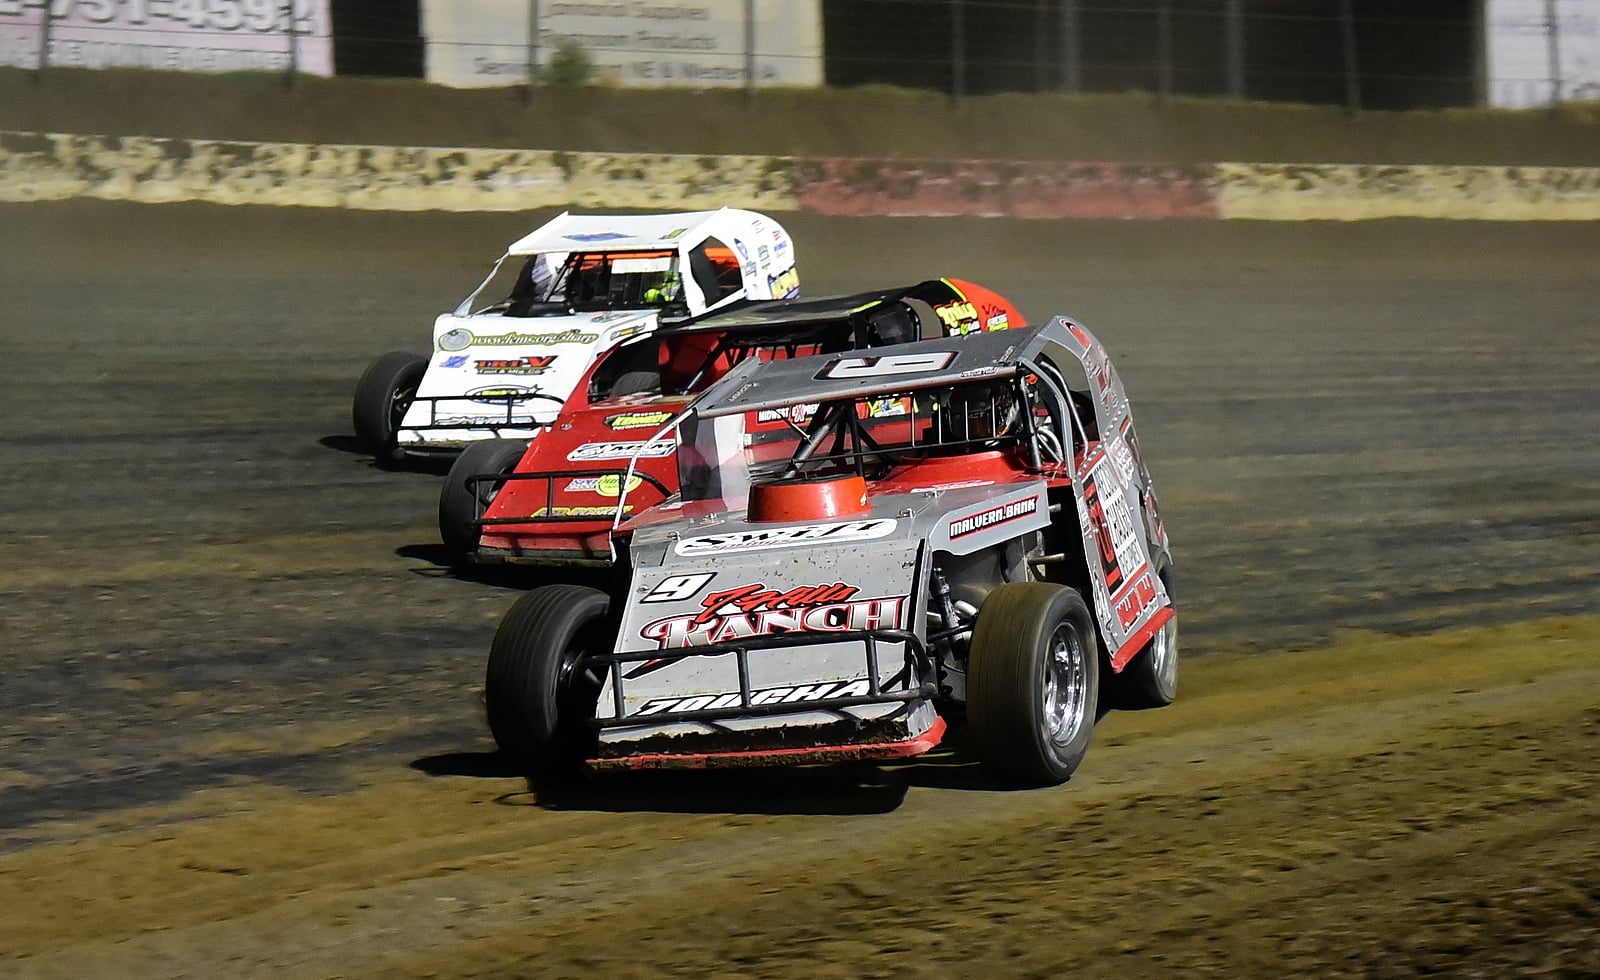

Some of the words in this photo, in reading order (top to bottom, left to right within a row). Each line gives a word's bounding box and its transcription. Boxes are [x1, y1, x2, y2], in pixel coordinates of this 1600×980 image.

[611, 412, 673, 427] KENNEDY
[639, 572, 717, 604] 9
[640, 598, 904, 650] RANCH
